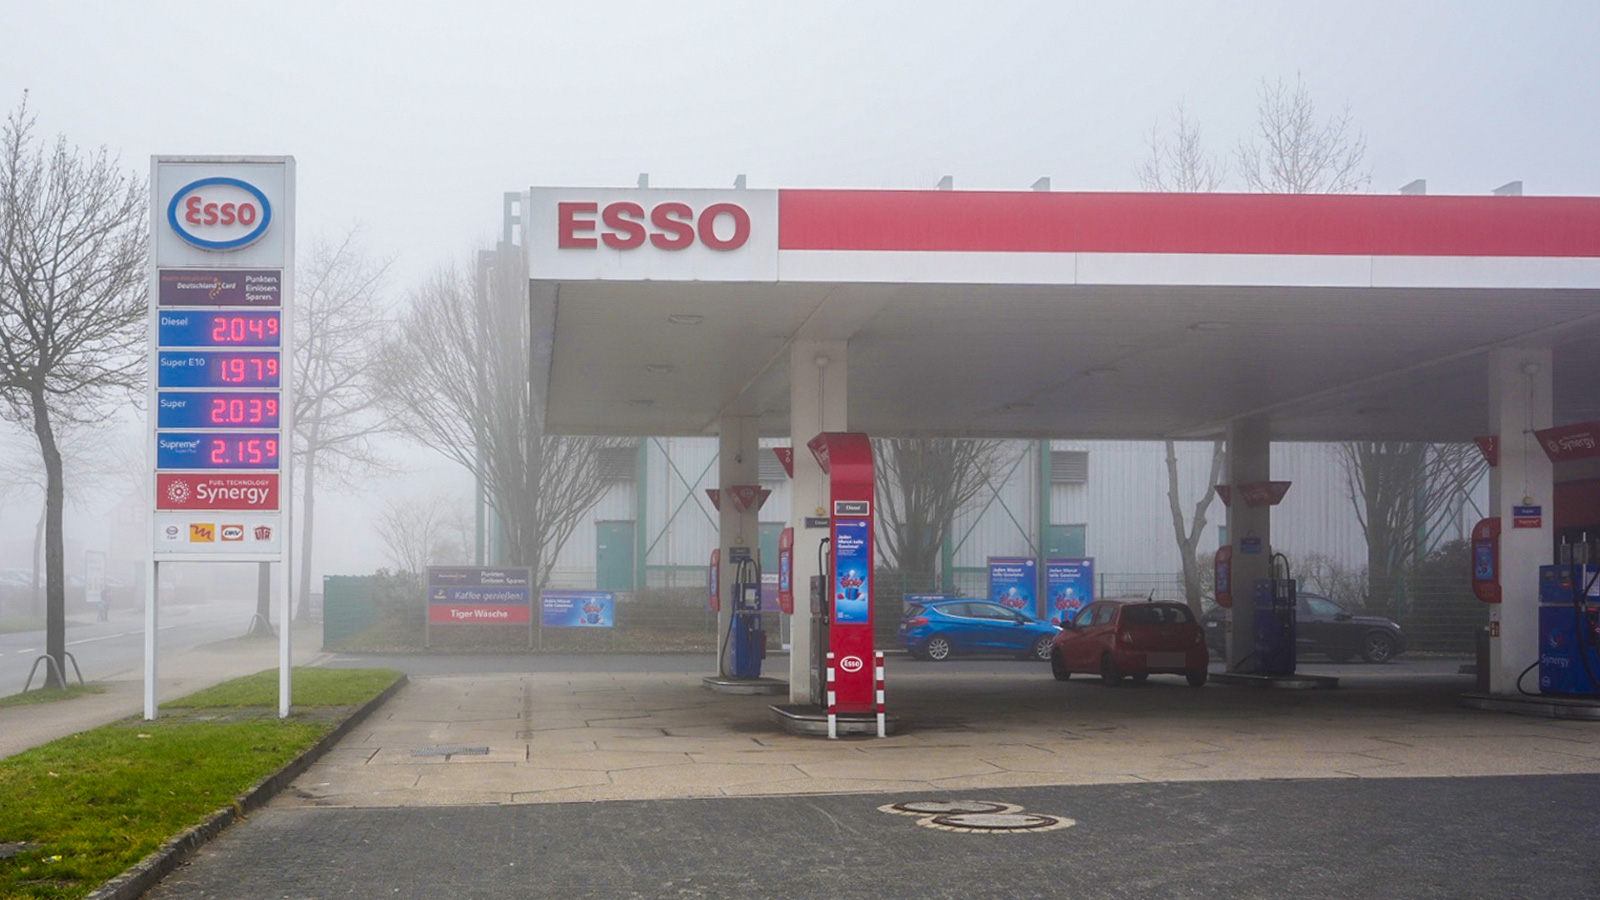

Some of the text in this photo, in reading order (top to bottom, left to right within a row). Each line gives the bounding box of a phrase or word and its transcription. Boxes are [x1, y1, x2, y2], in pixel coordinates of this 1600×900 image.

[185, 196, 256, 225] Esso
[558, 202, 751, 250] ESSO
[246, 293, 273, 301] Sparen.
[161, 317, 188, 326] Diesel
[160, 358, 186, 368] Super
[188, 358, 205, 366] E10
[160, 400, 186, 409] Super
[1558, 437, 1595, 451] Synergy
[196, 484, 269, 503] Synergy
[454, 591, 481, 600] Kaffee
[451, 610, 472, 619] Tiger
[844, 659, 860, 667] Esso
[1542, 654, 1569, 668] Synergy
